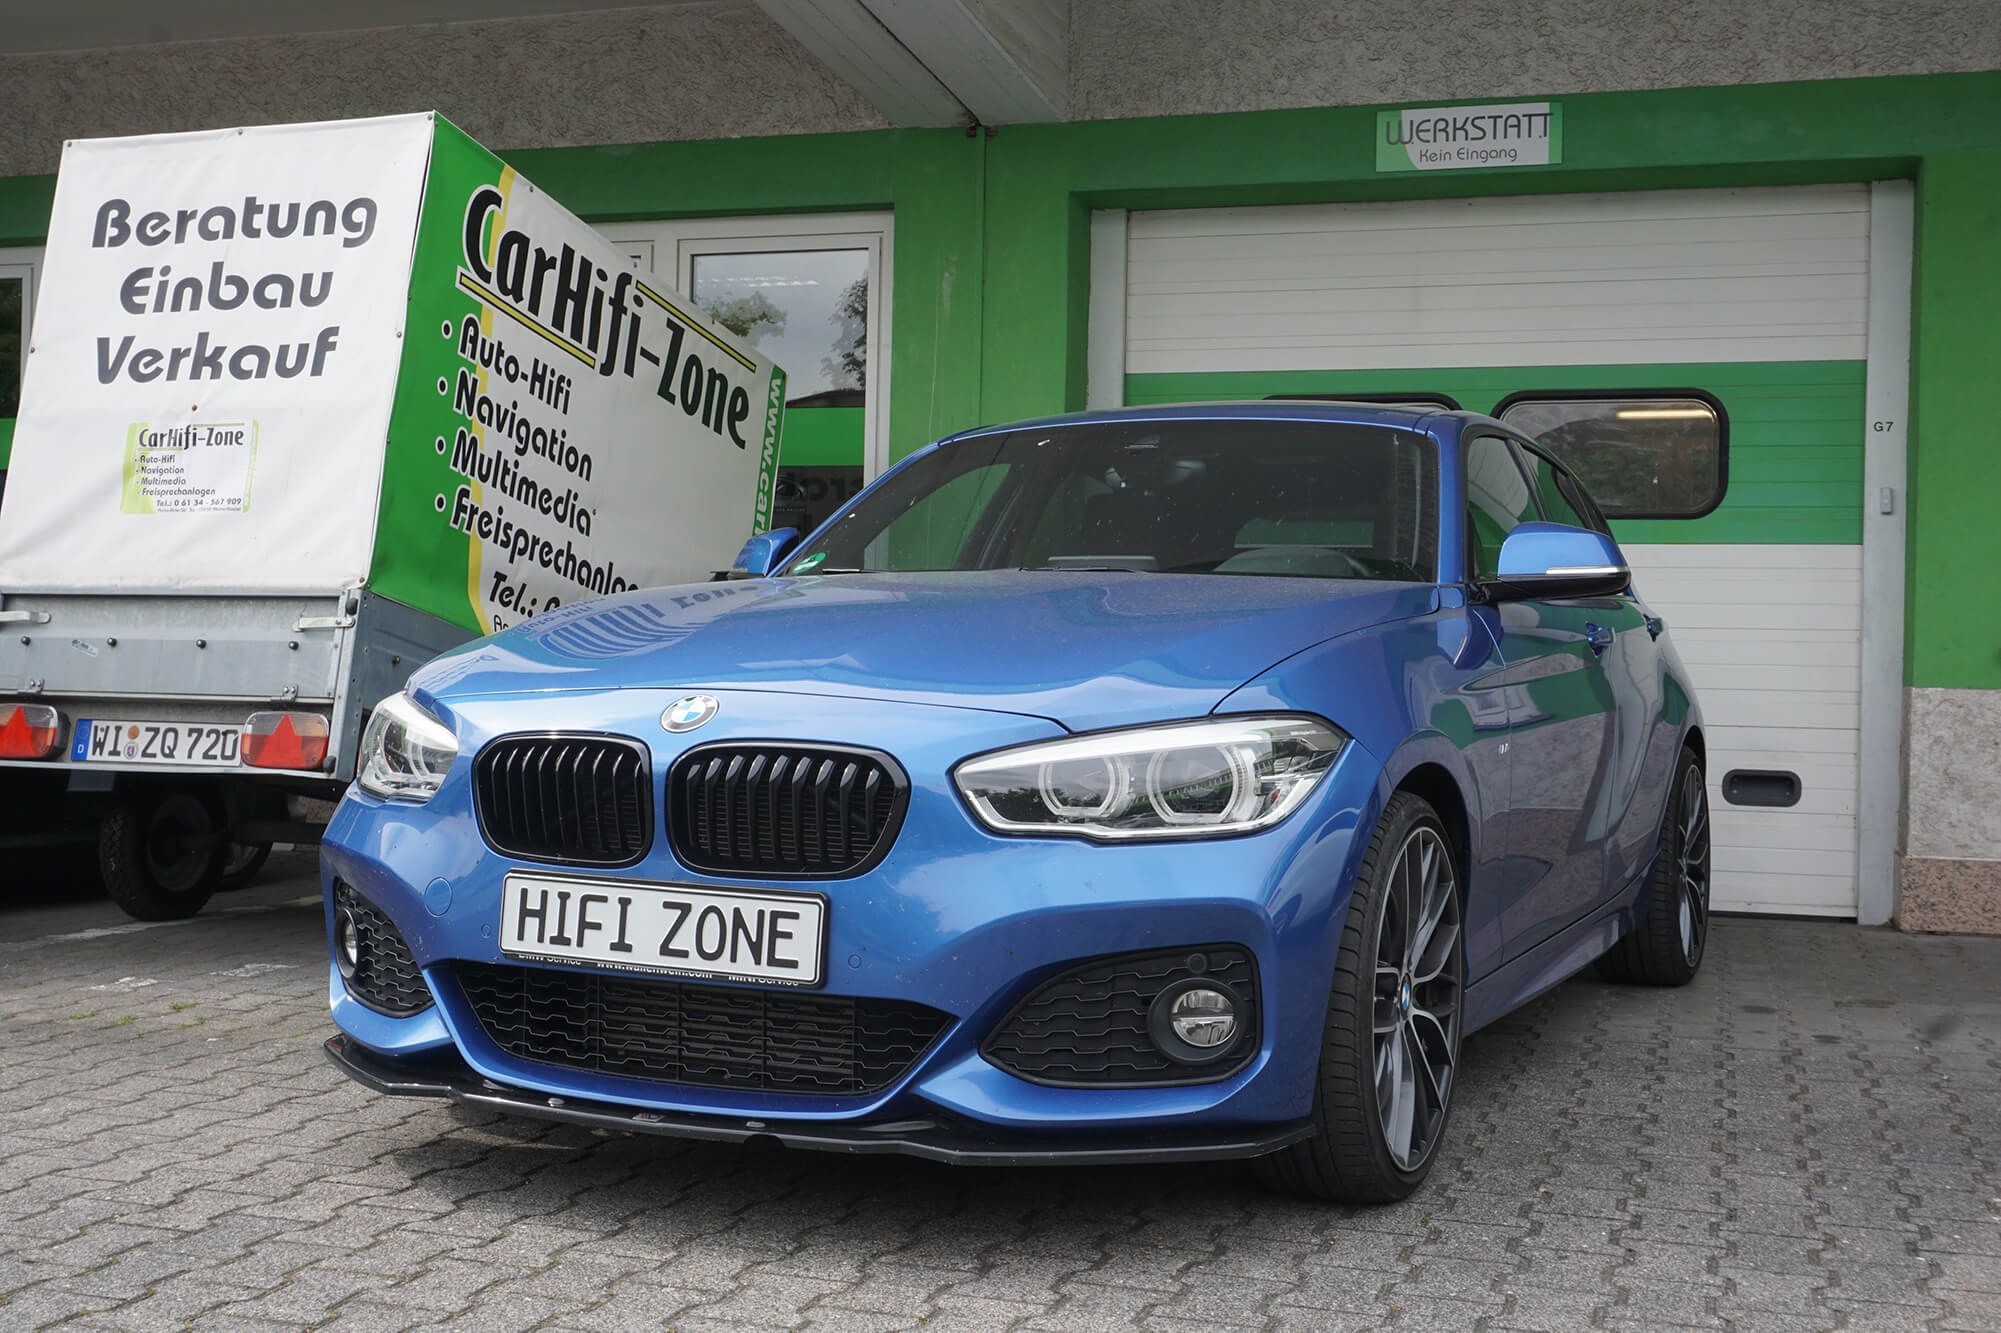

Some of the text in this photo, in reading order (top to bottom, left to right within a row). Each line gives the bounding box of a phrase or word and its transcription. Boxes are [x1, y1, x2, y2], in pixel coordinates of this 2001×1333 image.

[1386, 112, 1554, 146] WERKSTATT
[1419, 147, 1518, 163] Kein Eingang
[92, 196, 378, 248] Beratung
[120, 261, 334, 315] Einbau
[465, 188, 750, 449] CarHifi-Zone
[96, 326, 340, 385] Verkauf
[459, 316, 572, 415] Auto-Hifi
[139, 424, 244, 450] CarHifi-Zone
[455, 369, 593, 482] Navigation
[1873, 421, 1894, 432] G7
[140, 454, 175, 463] Auto-Hifi
[141, 466, 185, 476] Navigation
[141, 477, 186, 485] Multimedia
[142, 487, 216, 498] Freisprechanlagen
[452, 428, 592, 537] Multimedia
[452, 487, 639, 595] Freisprechanla
[77, 743, 85, 755] D
[91, 725, 239, 761] WI ZQ 720
[516, 887, 801, 969] HIFI ZONE
